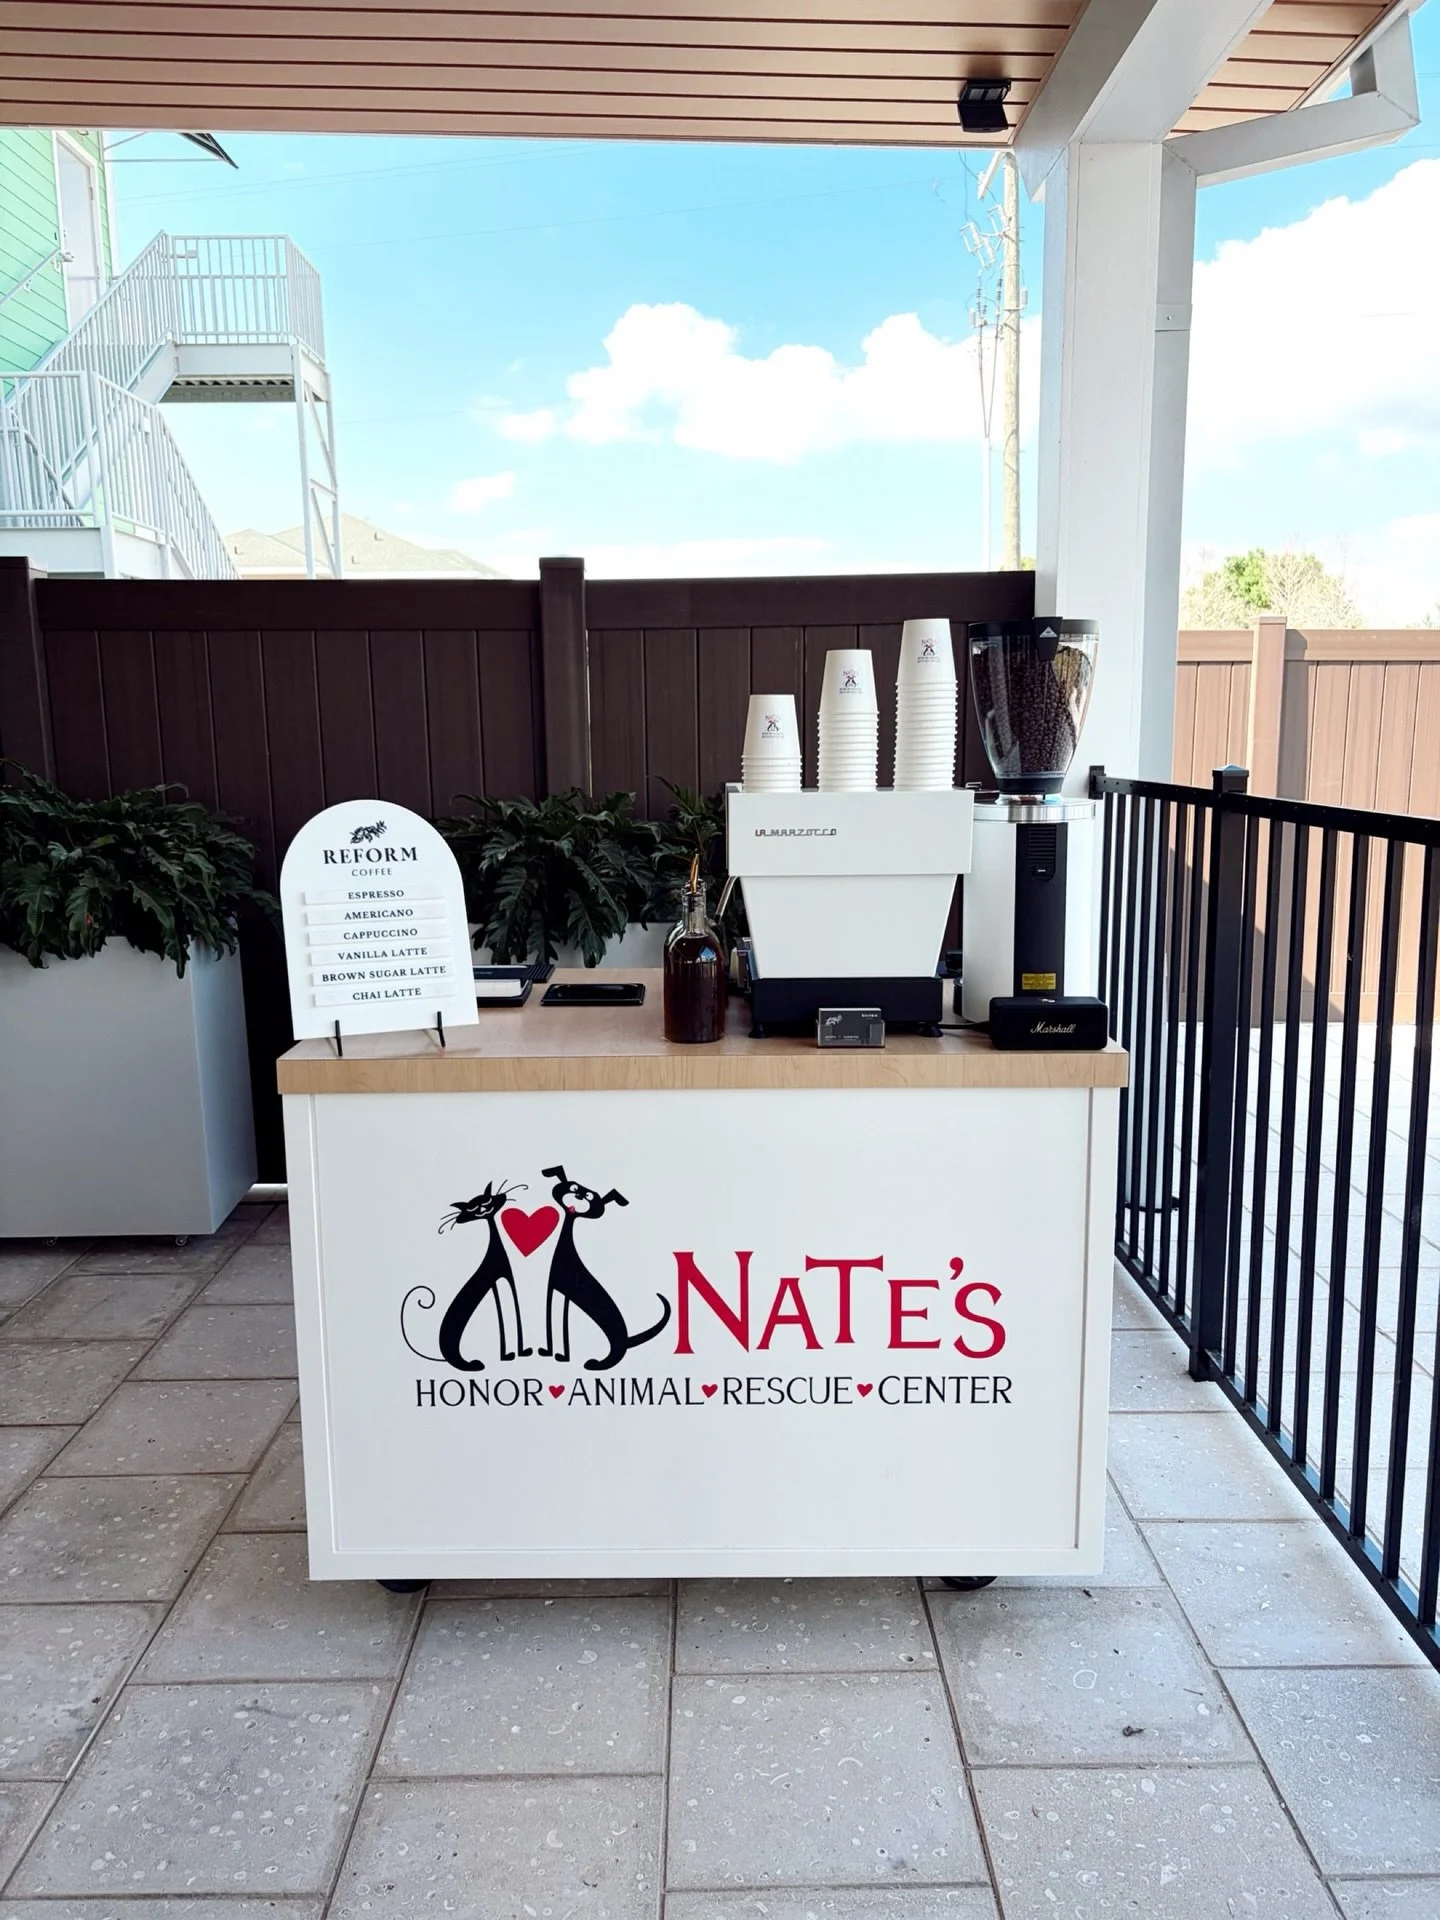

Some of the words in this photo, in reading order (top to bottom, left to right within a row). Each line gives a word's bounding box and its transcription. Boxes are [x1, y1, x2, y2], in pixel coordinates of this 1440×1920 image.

[755, 829, 766, 837] LA
[323, 847, 418, 864] REFORM
[351, 868, 392, 877] COFFEE
[348, 890, 404, 899] ESPRESSO
[344, 909, 413, 920] AMERICANO
[344, 928, 417, 940] CAPPUCCINO
[338, 951, 387, 960] VANILLA
[392, 948, 427, 957] LATTE
[322, 972, 365, 982] BROWN
[370, 969, 406, 978] SUGAR
[410, 966, 446, 975] LATTE
[353, 991, 380, 1000] CHAI
[385, 988, 421, 998] LATTE
[1030, 1021, 1076, 1034] Marshall
[673, 1251, 1006, 1359] NATE'S
[416, 1379, 543, 1407] HONOR
[568, 1377, 704, 1406] ANIMAL
[723, 1377, 853, 1405] RESCUE
[878, 1376, 1012, 1405] CENTER
